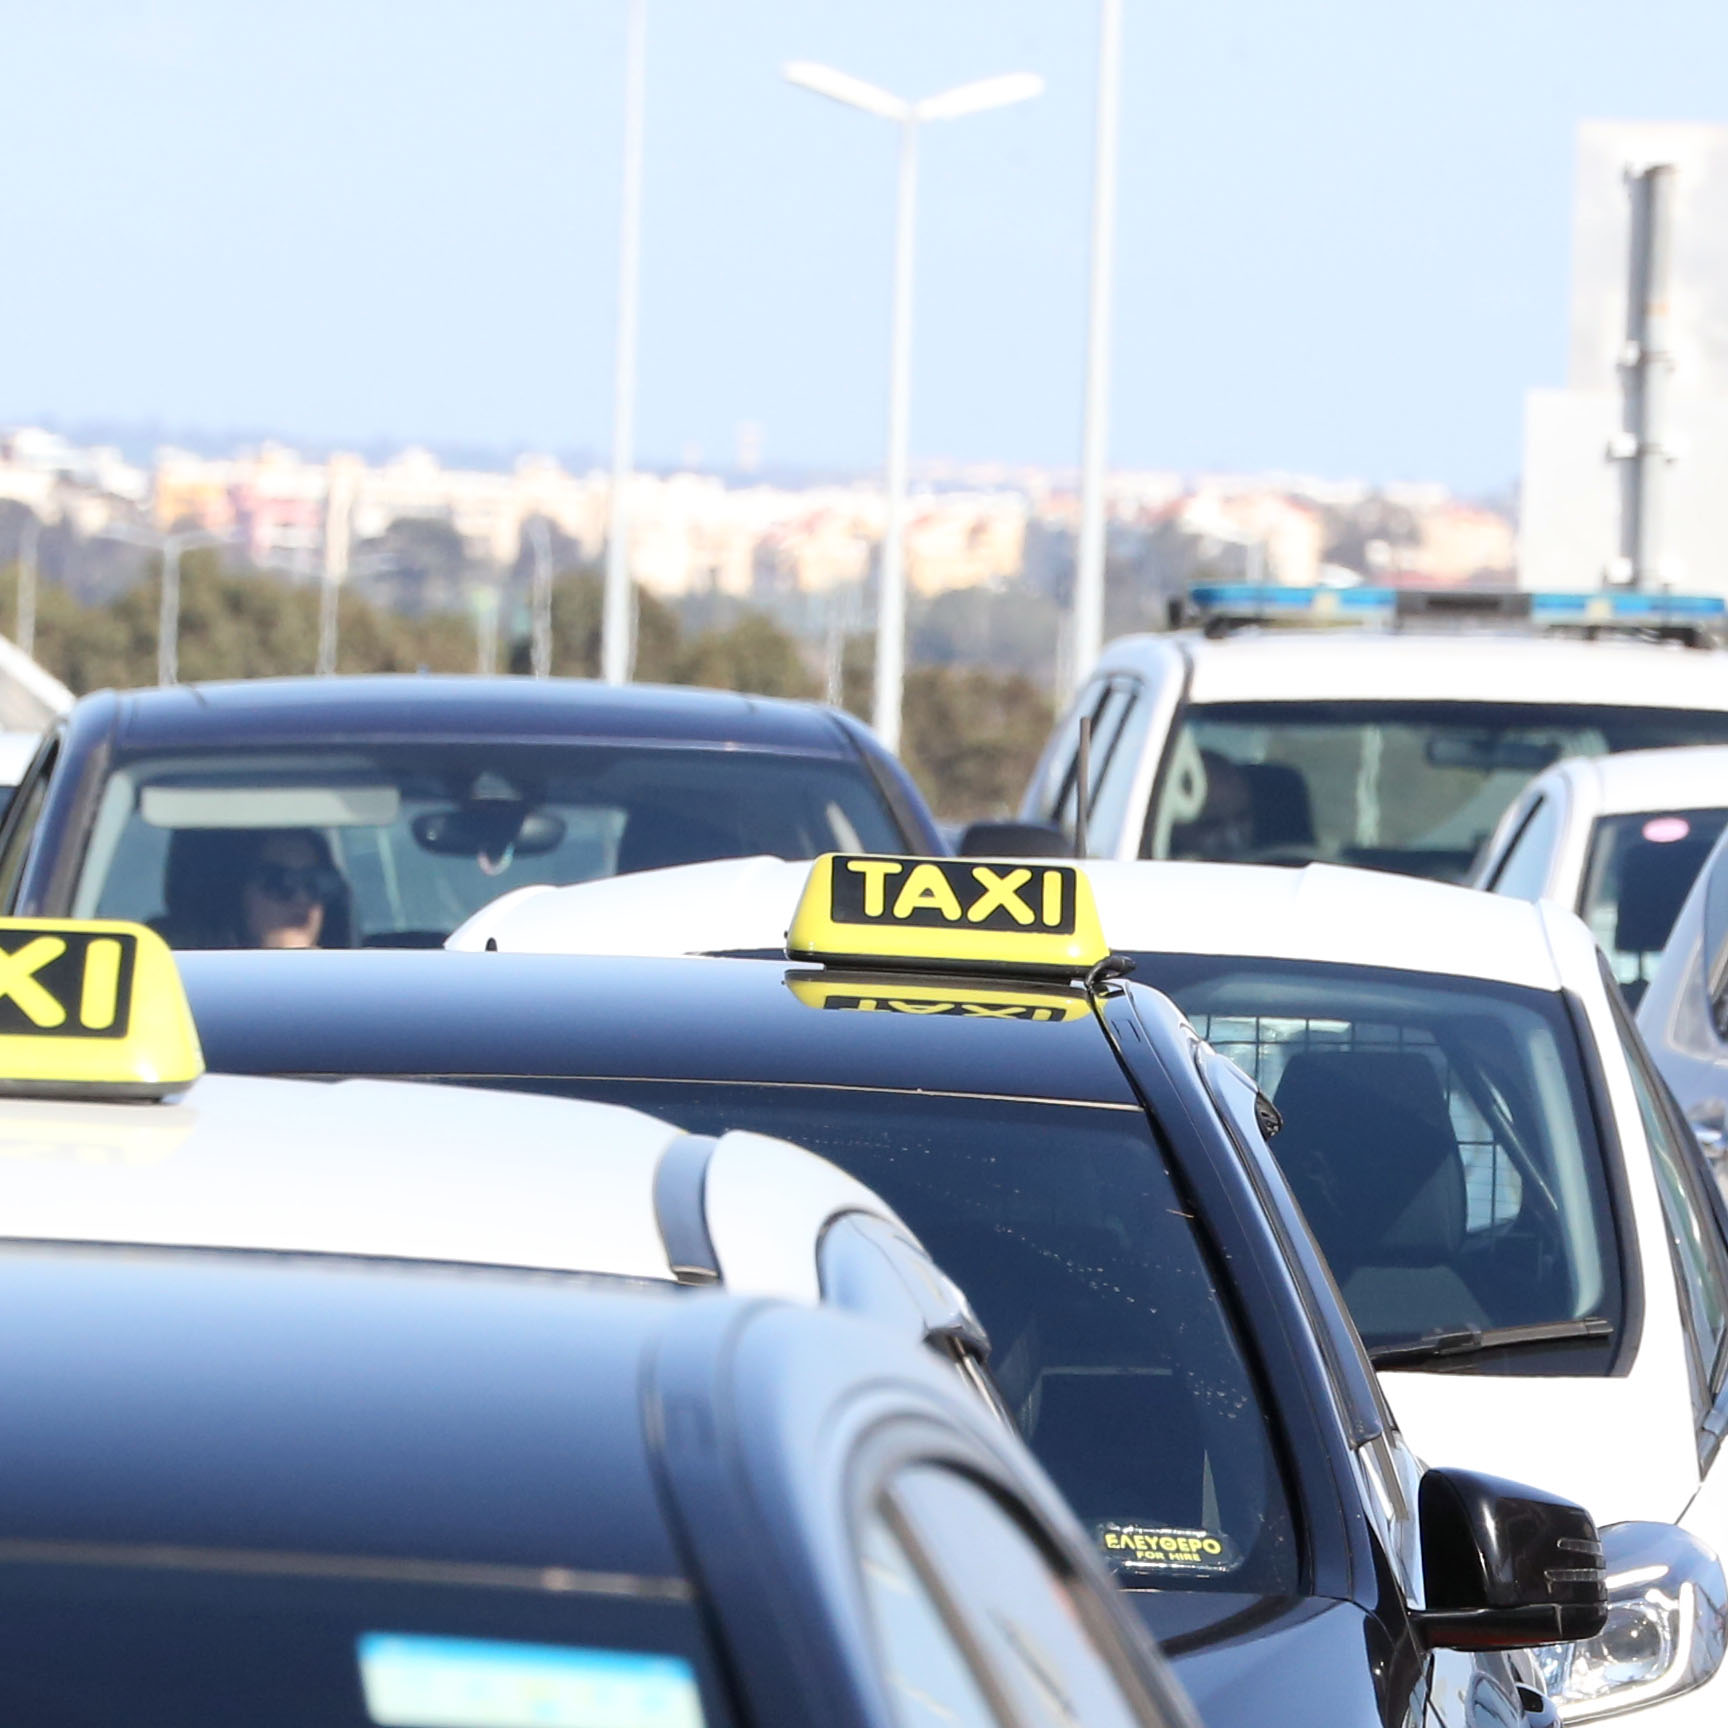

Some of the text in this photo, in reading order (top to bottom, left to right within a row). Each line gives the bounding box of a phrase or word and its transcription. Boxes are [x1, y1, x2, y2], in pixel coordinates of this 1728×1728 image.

[846, 860, 1063, 927] TAXI
[1104, 1532, 1222, 1555] ΕΛΕΥΘΕΡΟ
[1135, 1550, 1202, 1562] FOR HIRE
